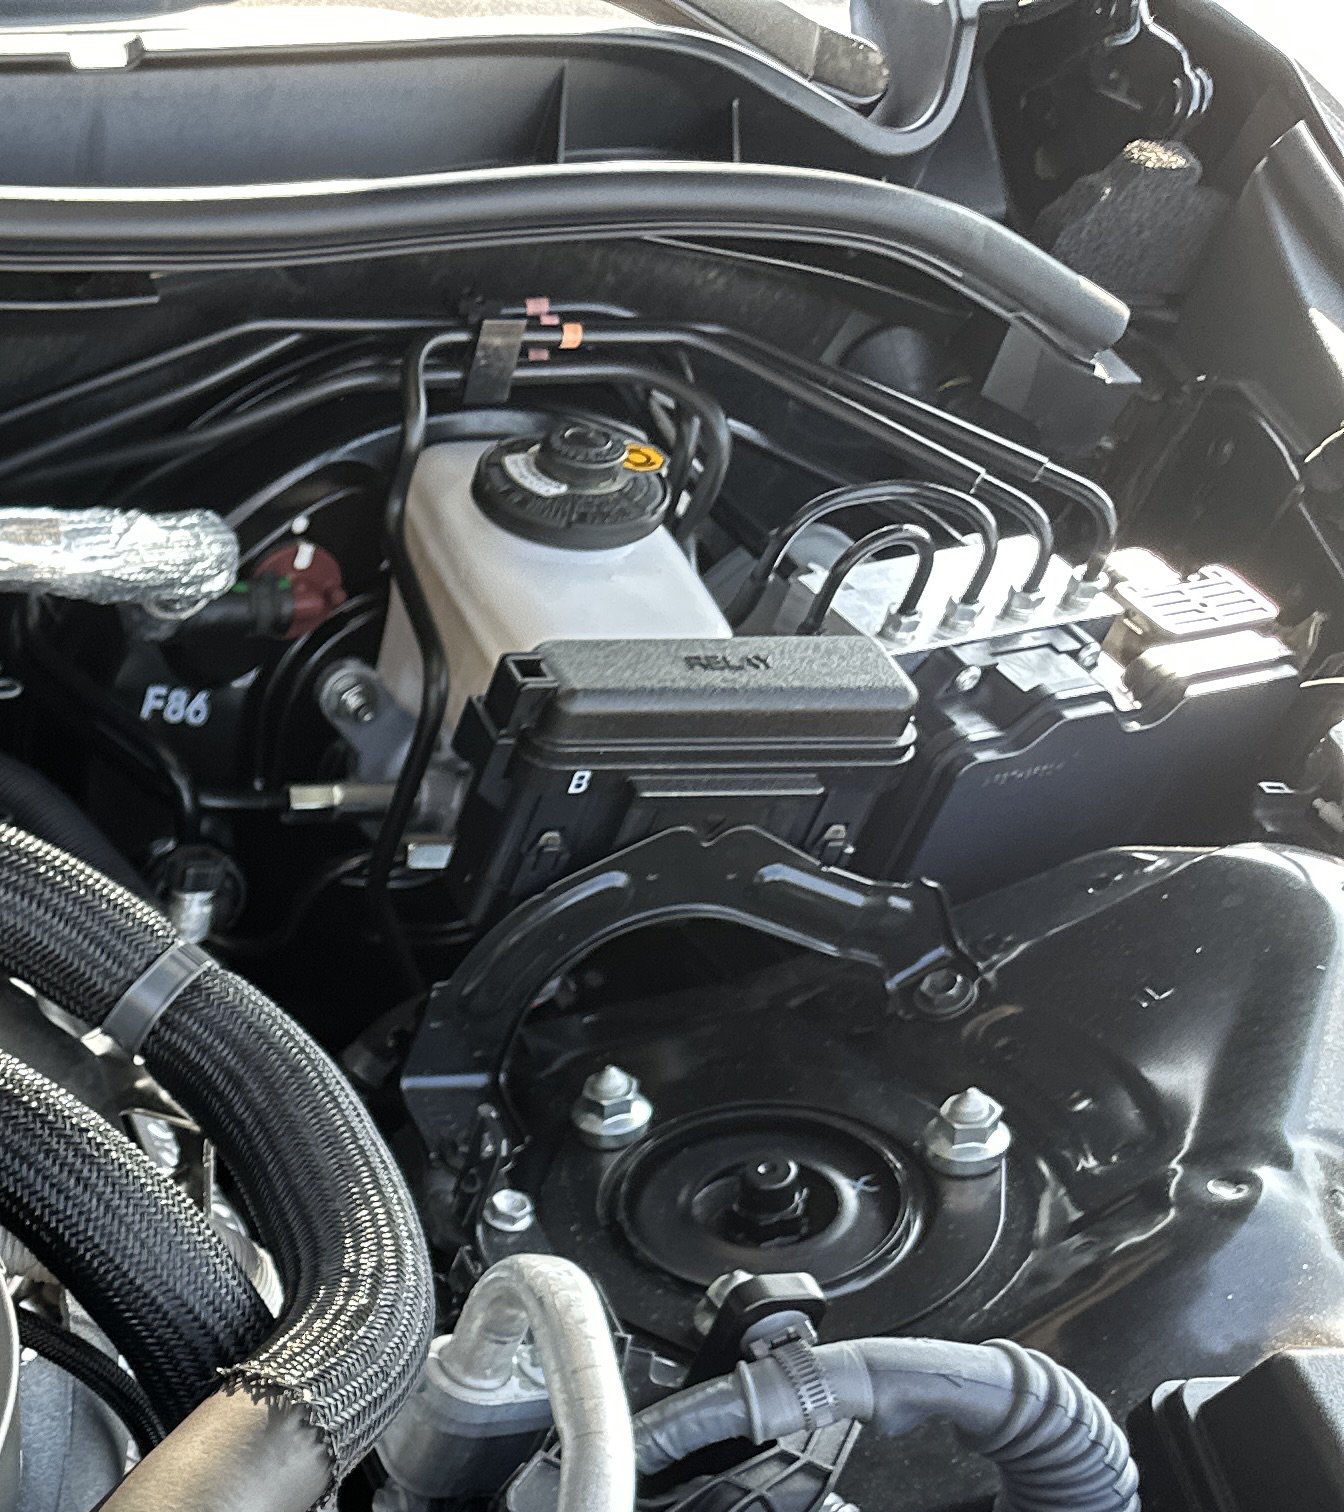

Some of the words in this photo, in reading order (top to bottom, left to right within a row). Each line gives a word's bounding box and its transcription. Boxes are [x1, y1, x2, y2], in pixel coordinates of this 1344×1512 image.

[683, 653, 772, 673] RELAY
[140, 685, 210, 727] F86
[566, 769, 591, 796] B
